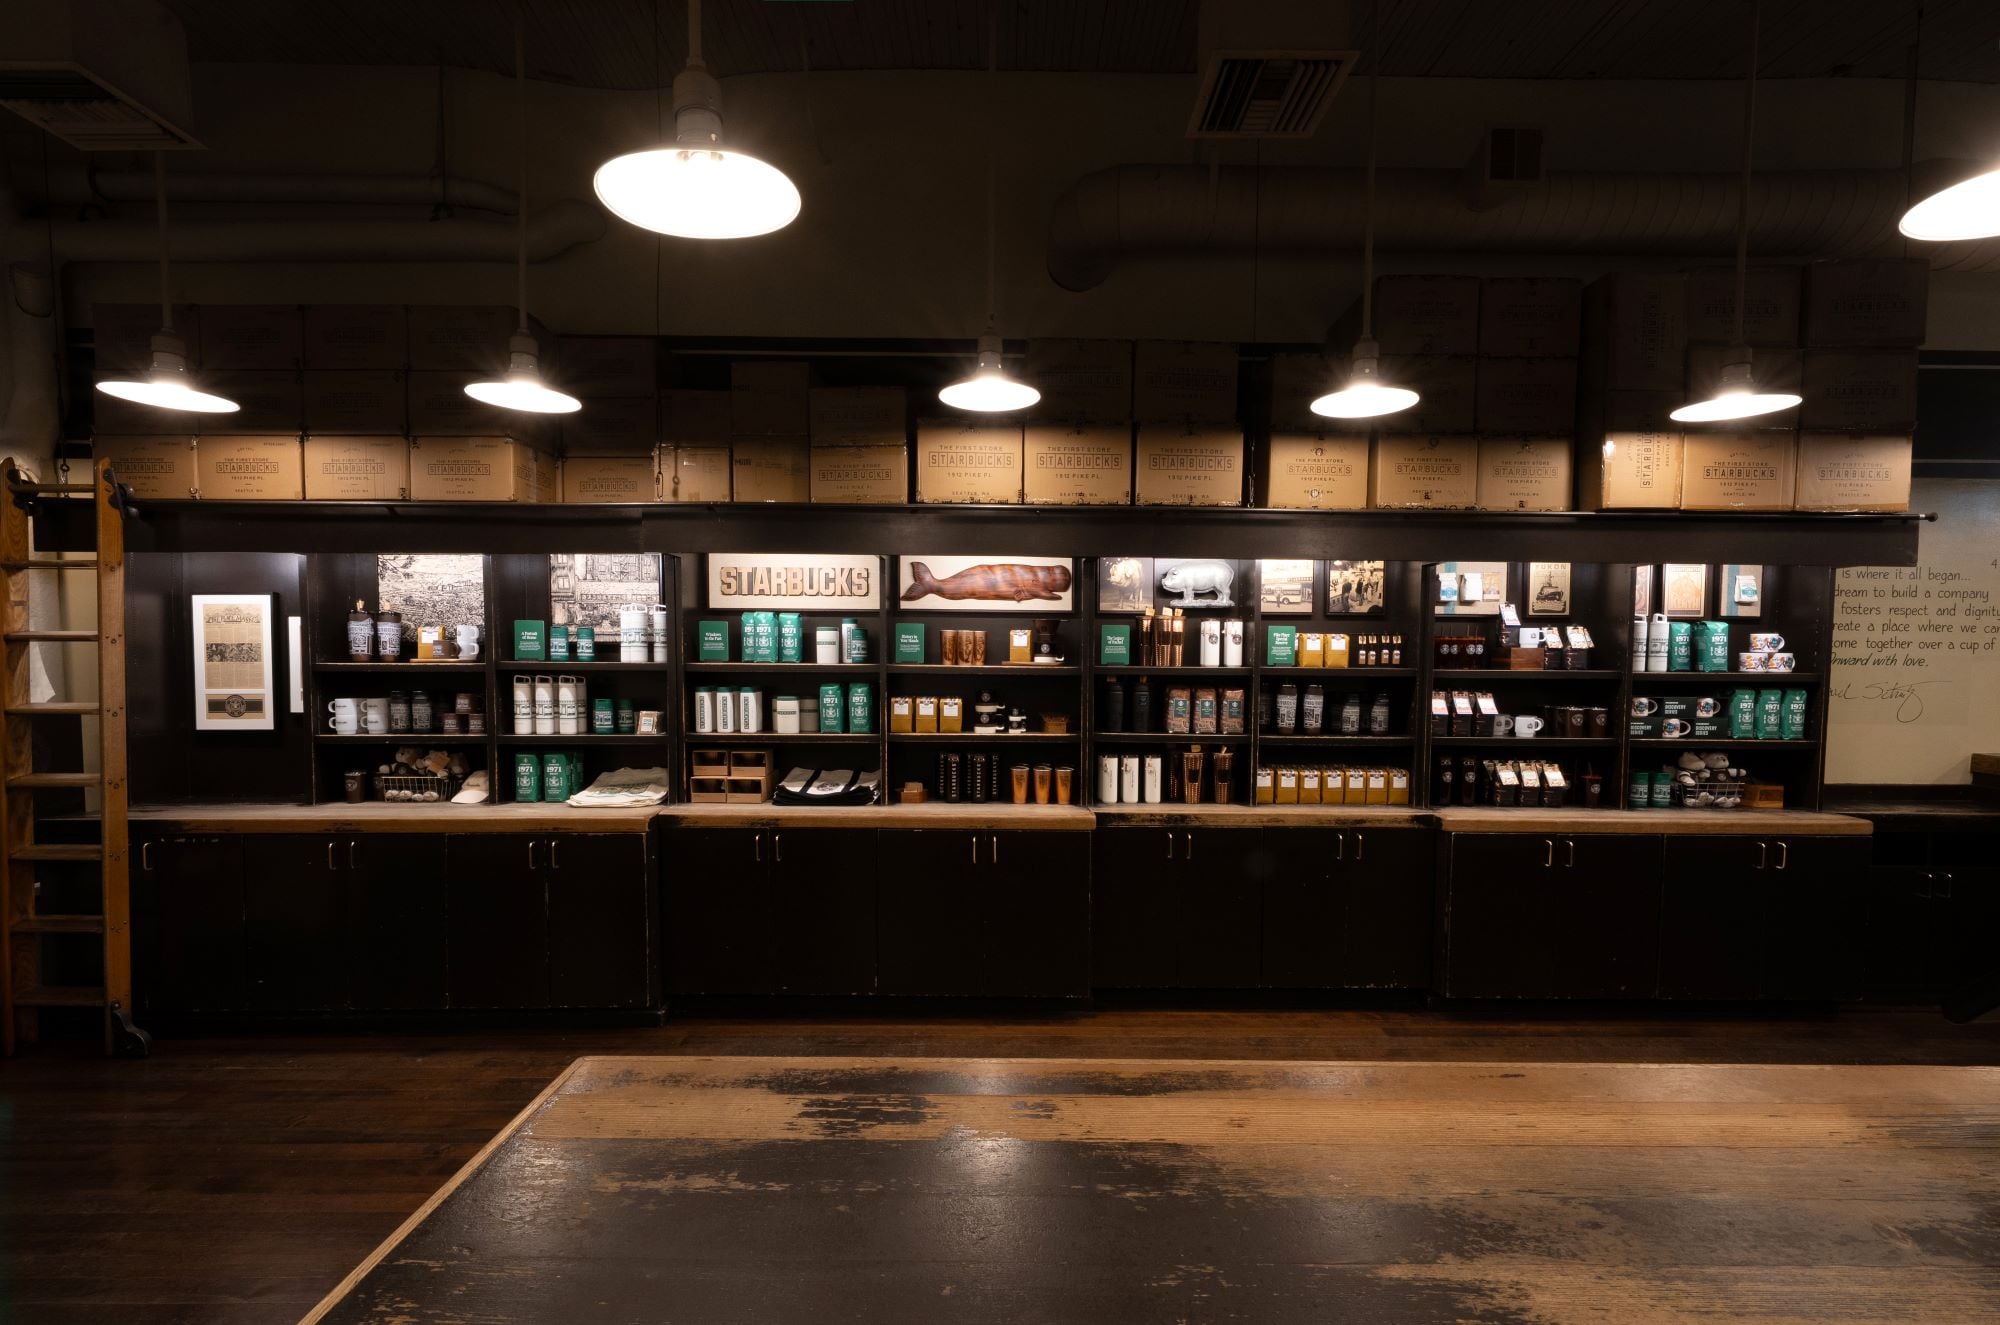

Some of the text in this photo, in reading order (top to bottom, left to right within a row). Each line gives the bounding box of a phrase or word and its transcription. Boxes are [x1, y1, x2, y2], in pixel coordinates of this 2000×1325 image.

[930, 454, 1013, 466] STARBUCKS
[1039, 455, 1120, 467] STARBUCKS
[1151, 456, 1233, 469] STARBUCKS
[218, 464, 278, 472] STARBUCKS
[1288, 465, 1351, 474] STARBUCKS
[1396, 464, 1460, 474] STARBUCKS
[1494, 467, 1557, 476] STARBUCKS
[1705, 468, 1775, 478] STARBUCKS
[1820, 469, 1889, 479] STARBUCKS
[720, 566, 869, 596] STARBUCKS
[1856, 567, 1890, 580] where
[1895, 568, 1903, 580] it
[1908, 567, 1921, 580] all
[1928, 567, 1971, 584] began...
[1833, 584, 1989, 603] dream to build a company
[1841, 601, 1881, 615] fosters
[1889, 605, 1928, 618] respect
[1936, 602, 1956, 616] and
[1832, 619, 1861, 632] reate
[1867, 623, 1875, 632] a
[1882, 619, 1911, 635] place
[1918, 619, 1953, 633] where
[1960, 624, 1977, 633] we
[1832, 636, 1997, 655] ome together over a cup of
[1872, 653, 1898, 667] with
[1902, 653, 1929, 667] love.
